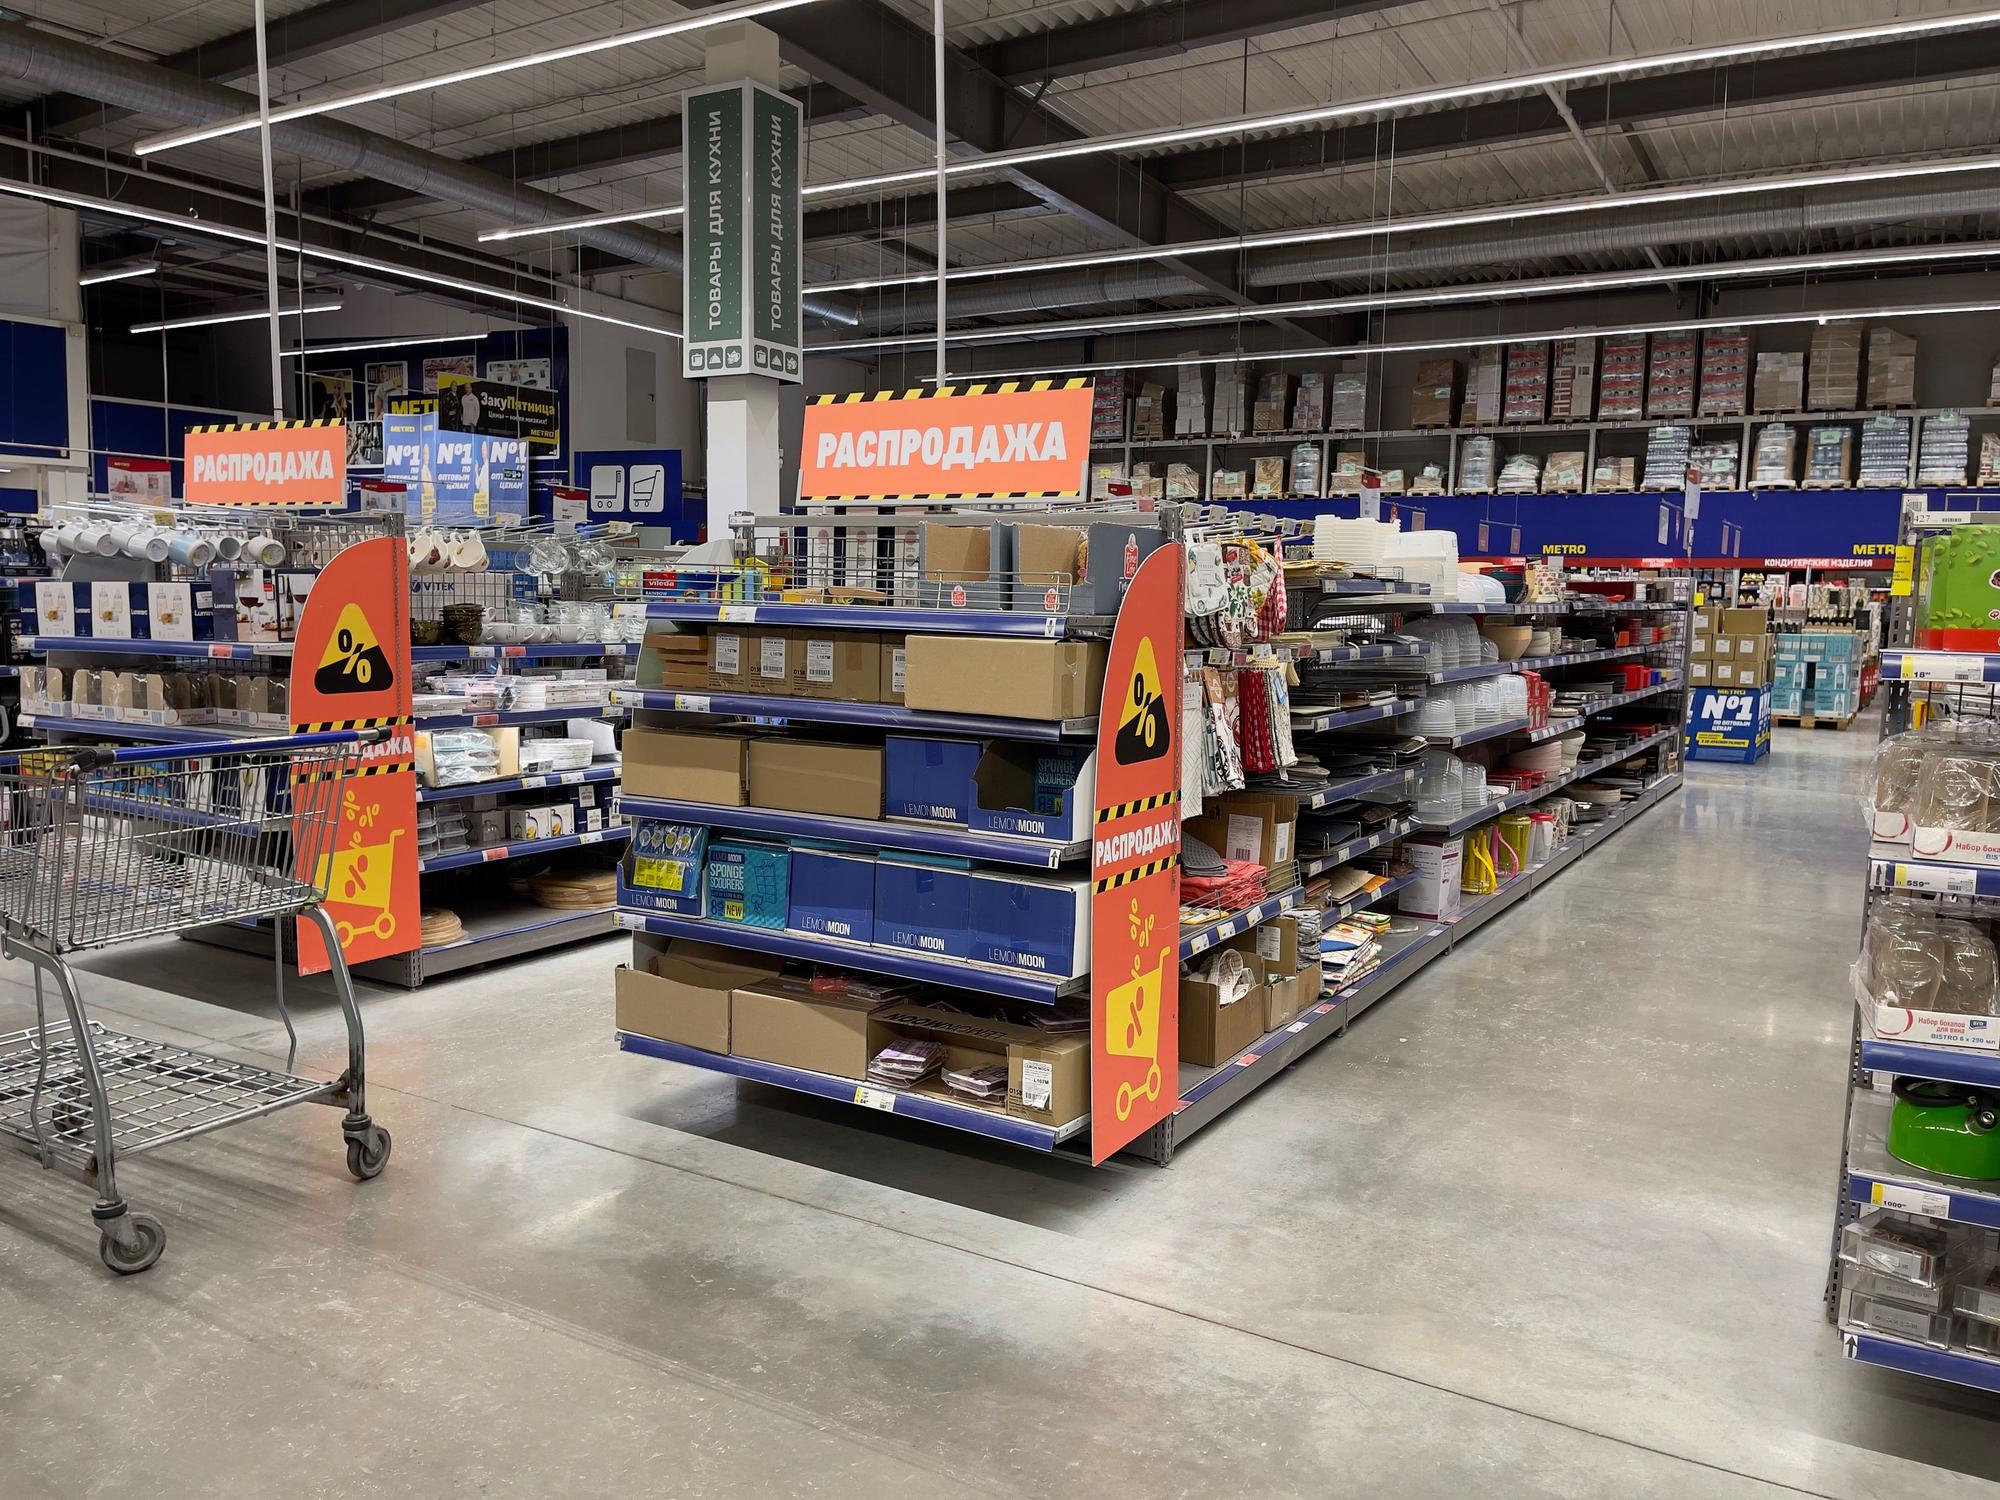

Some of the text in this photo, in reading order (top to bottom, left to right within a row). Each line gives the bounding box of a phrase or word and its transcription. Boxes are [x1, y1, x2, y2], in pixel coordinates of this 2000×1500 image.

[709, 110, 724, 330] ТОВАРЫ ДЛЯ КУХНИ
[771, 114, 783, 331] ТОВАРЫ ДЛЯ КУХНИ
[480, 391, 555, 416] ЗакуПятница
[530, 429, 554, 438] METRO
[816, 421, 1067, 470] РАСПРОДАЖА
[193, 450, 334, 485] РАСПРОДАЖА
[1542, 544, 1586, 554] METRO
[1853, 544, 1897, 555] METR
[1764, 558, 1873, 568] КОНДИТЕРСКИЕ ИЗДЕЛИЯ
[424, 582, 455, 591] VITEK
[1039, 758, 1076, 774] SPONGE
[1039, 773, 1077, 786] SCOURERS
[903, 802, 956, 820] LEMONMOON
[988, 816, 1045, 834] LEMONMOON
[1095, 819, 1180, 867] РАСПРОДАЖА
[1955, 842, 1981, 852] Набор
[710, 863, 745, 880] SPONGE
[710, 876, 745, 891] SCOURERS
[631, 894, 677, 910] LEMONMOON
[726, 904, 742, 917] NEW
[802, 916, 850, 935] LEMONMOON
[892, 930, 945, 951] LEMONMOON
[988, 947, 1045, 969] LEMONMOON
[1918, 1017, 1966, 1028] Набор бокалов
[1931, 1033, 1958, 1041] BISTRO
